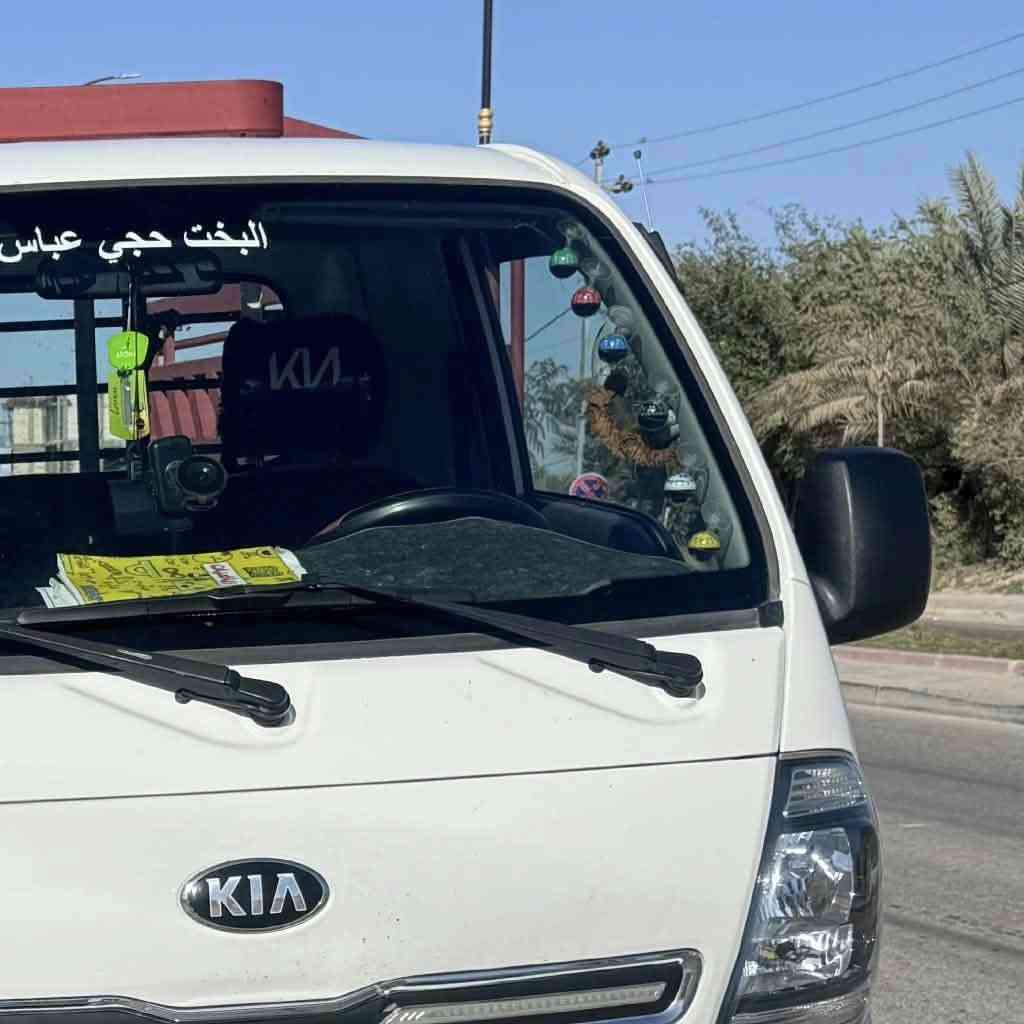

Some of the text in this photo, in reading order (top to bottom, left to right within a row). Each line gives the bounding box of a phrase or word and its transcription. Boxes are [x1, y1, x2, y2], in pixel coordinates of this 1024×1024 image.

[98, 229, 175, 264] حجي
[183, 219, 269, 255] البخت
[205, 872, 308, 918] KIA
